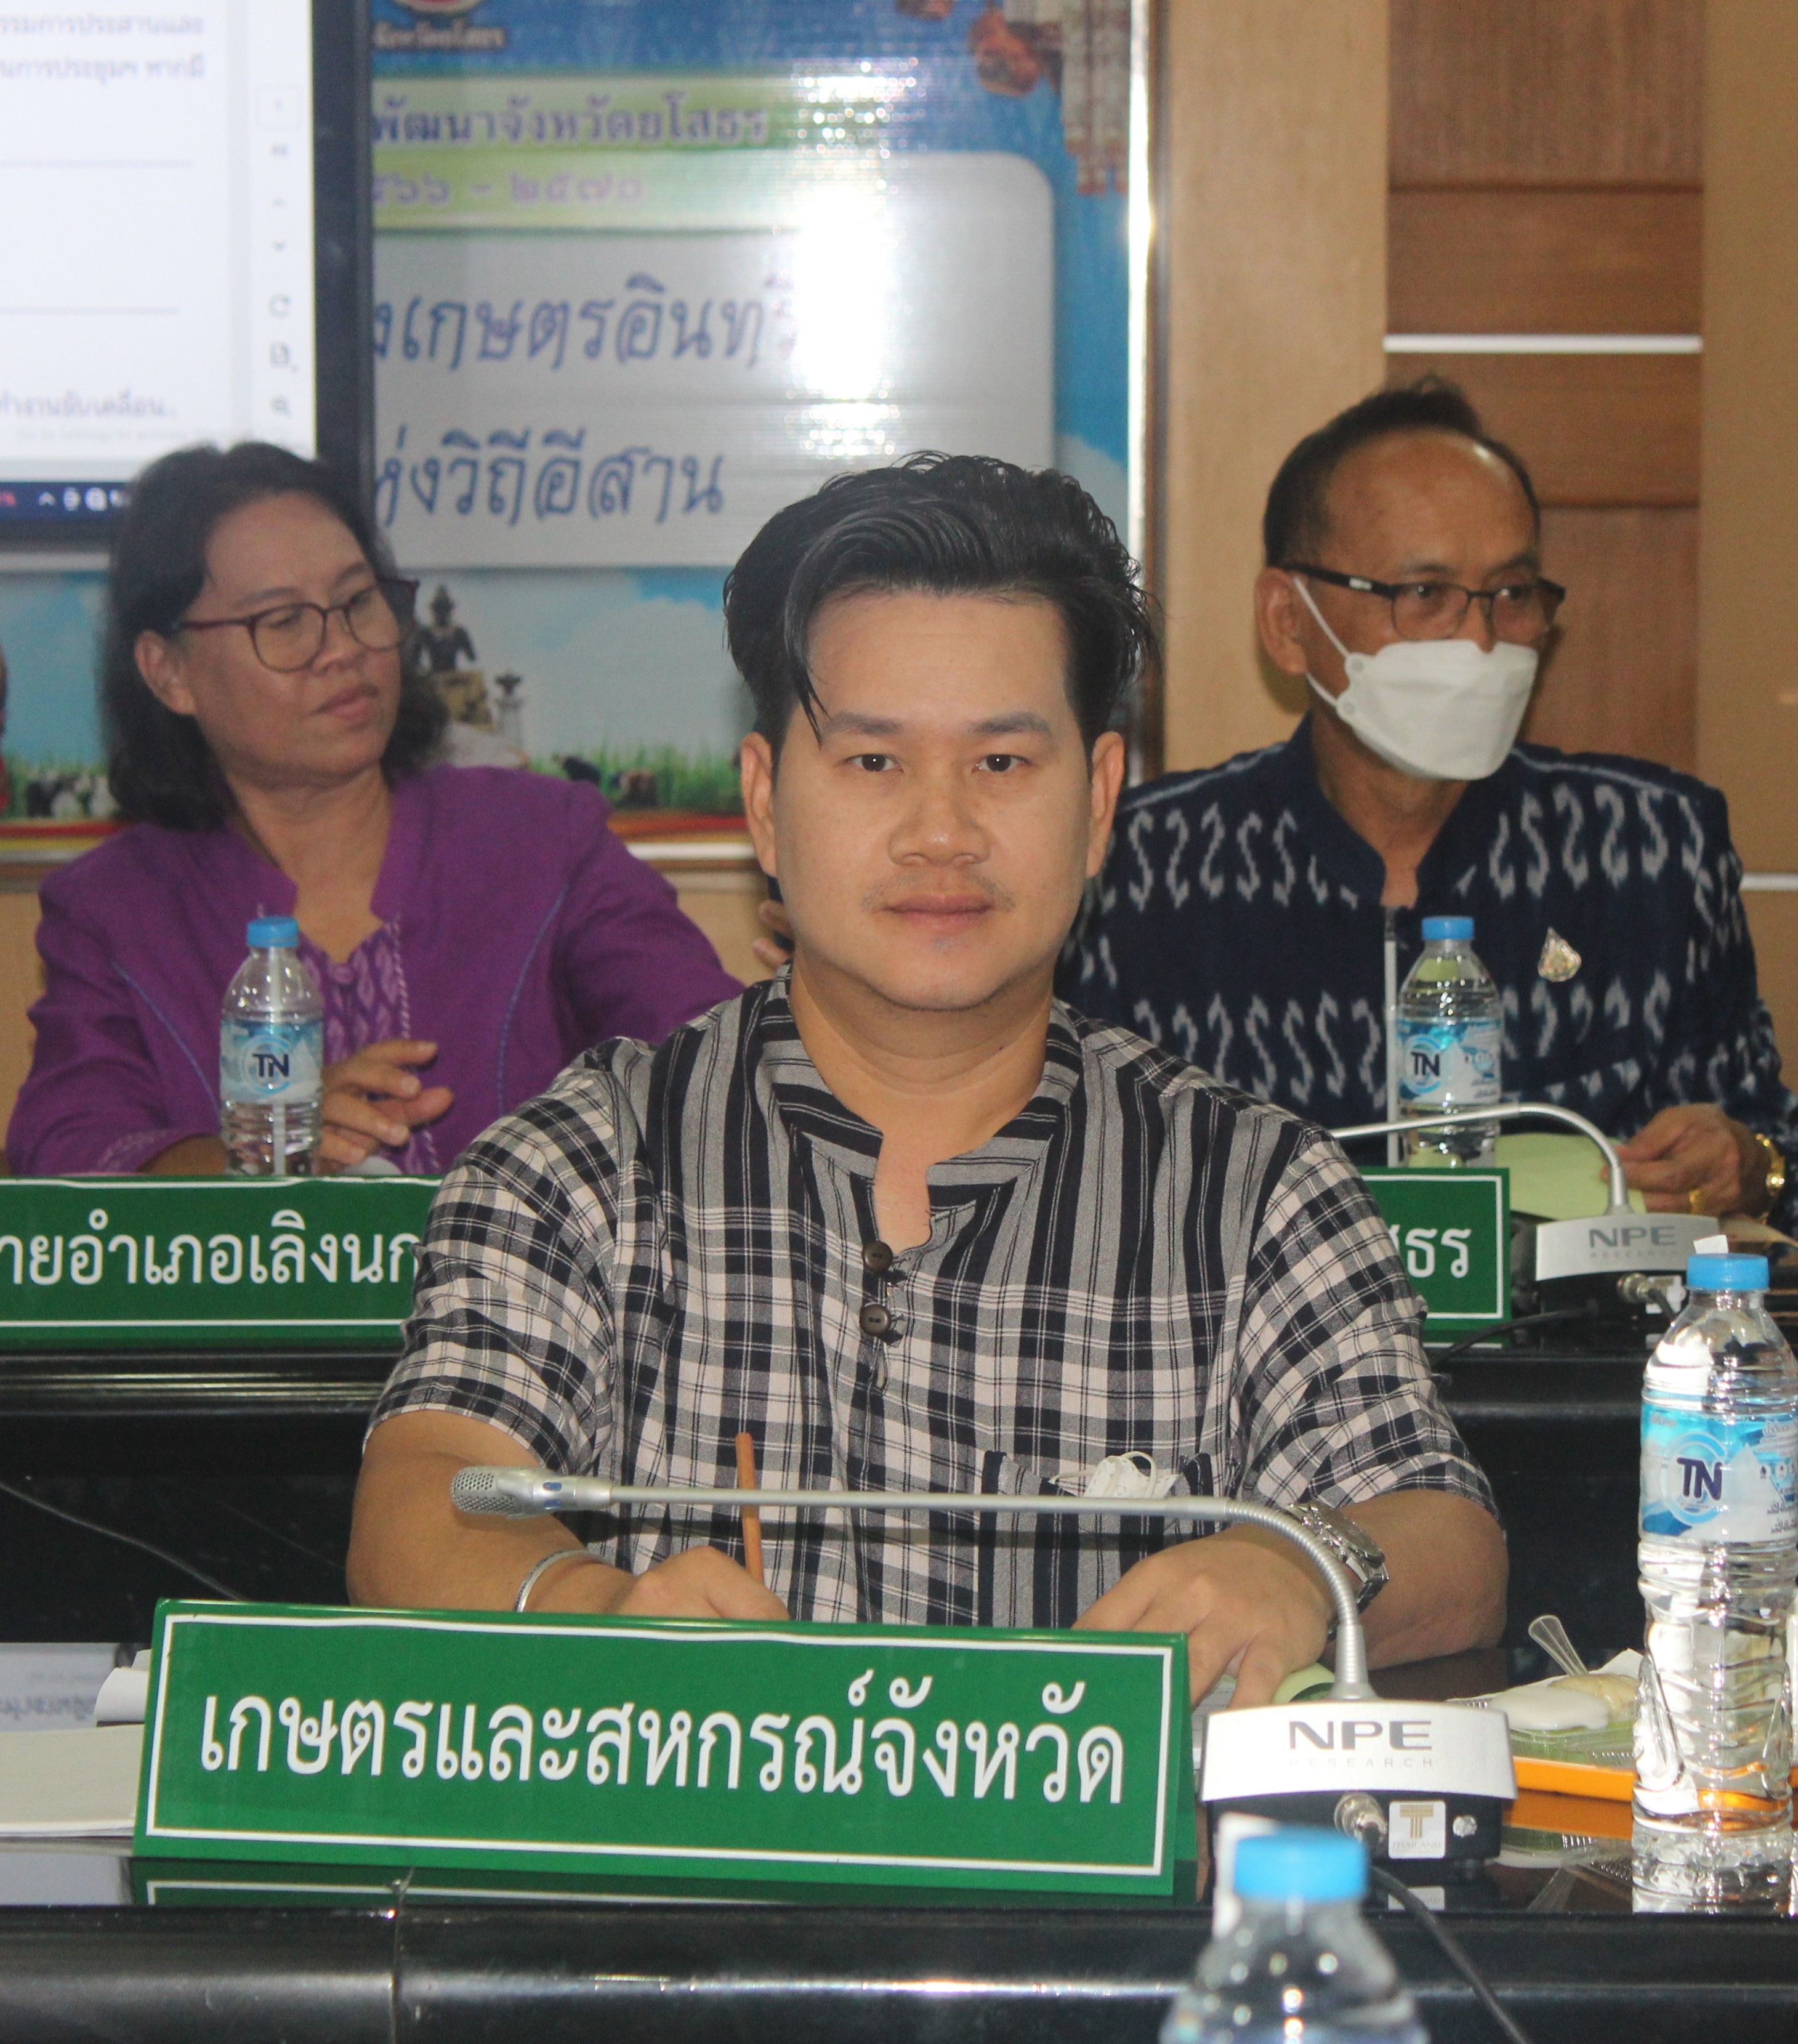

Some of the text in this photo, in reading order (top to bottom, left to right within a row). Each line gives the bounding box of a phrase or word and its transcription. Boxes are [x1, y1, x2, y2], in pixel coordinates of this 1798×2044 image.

[252, 1052, 290, 1078] TN
[1411, 1051, 1440, 1078] TN
[1589, 1225, 1677, 1248] NPE
[1676, 1457, 1723, 1501] TN
[200, 1668, 1124, 1804] เกษตรและสหกรณ์จังหวัด
[1289, 1721, 1432, 1751] NPE
[1289, 1758, 1433, 1768] RESEARCH
